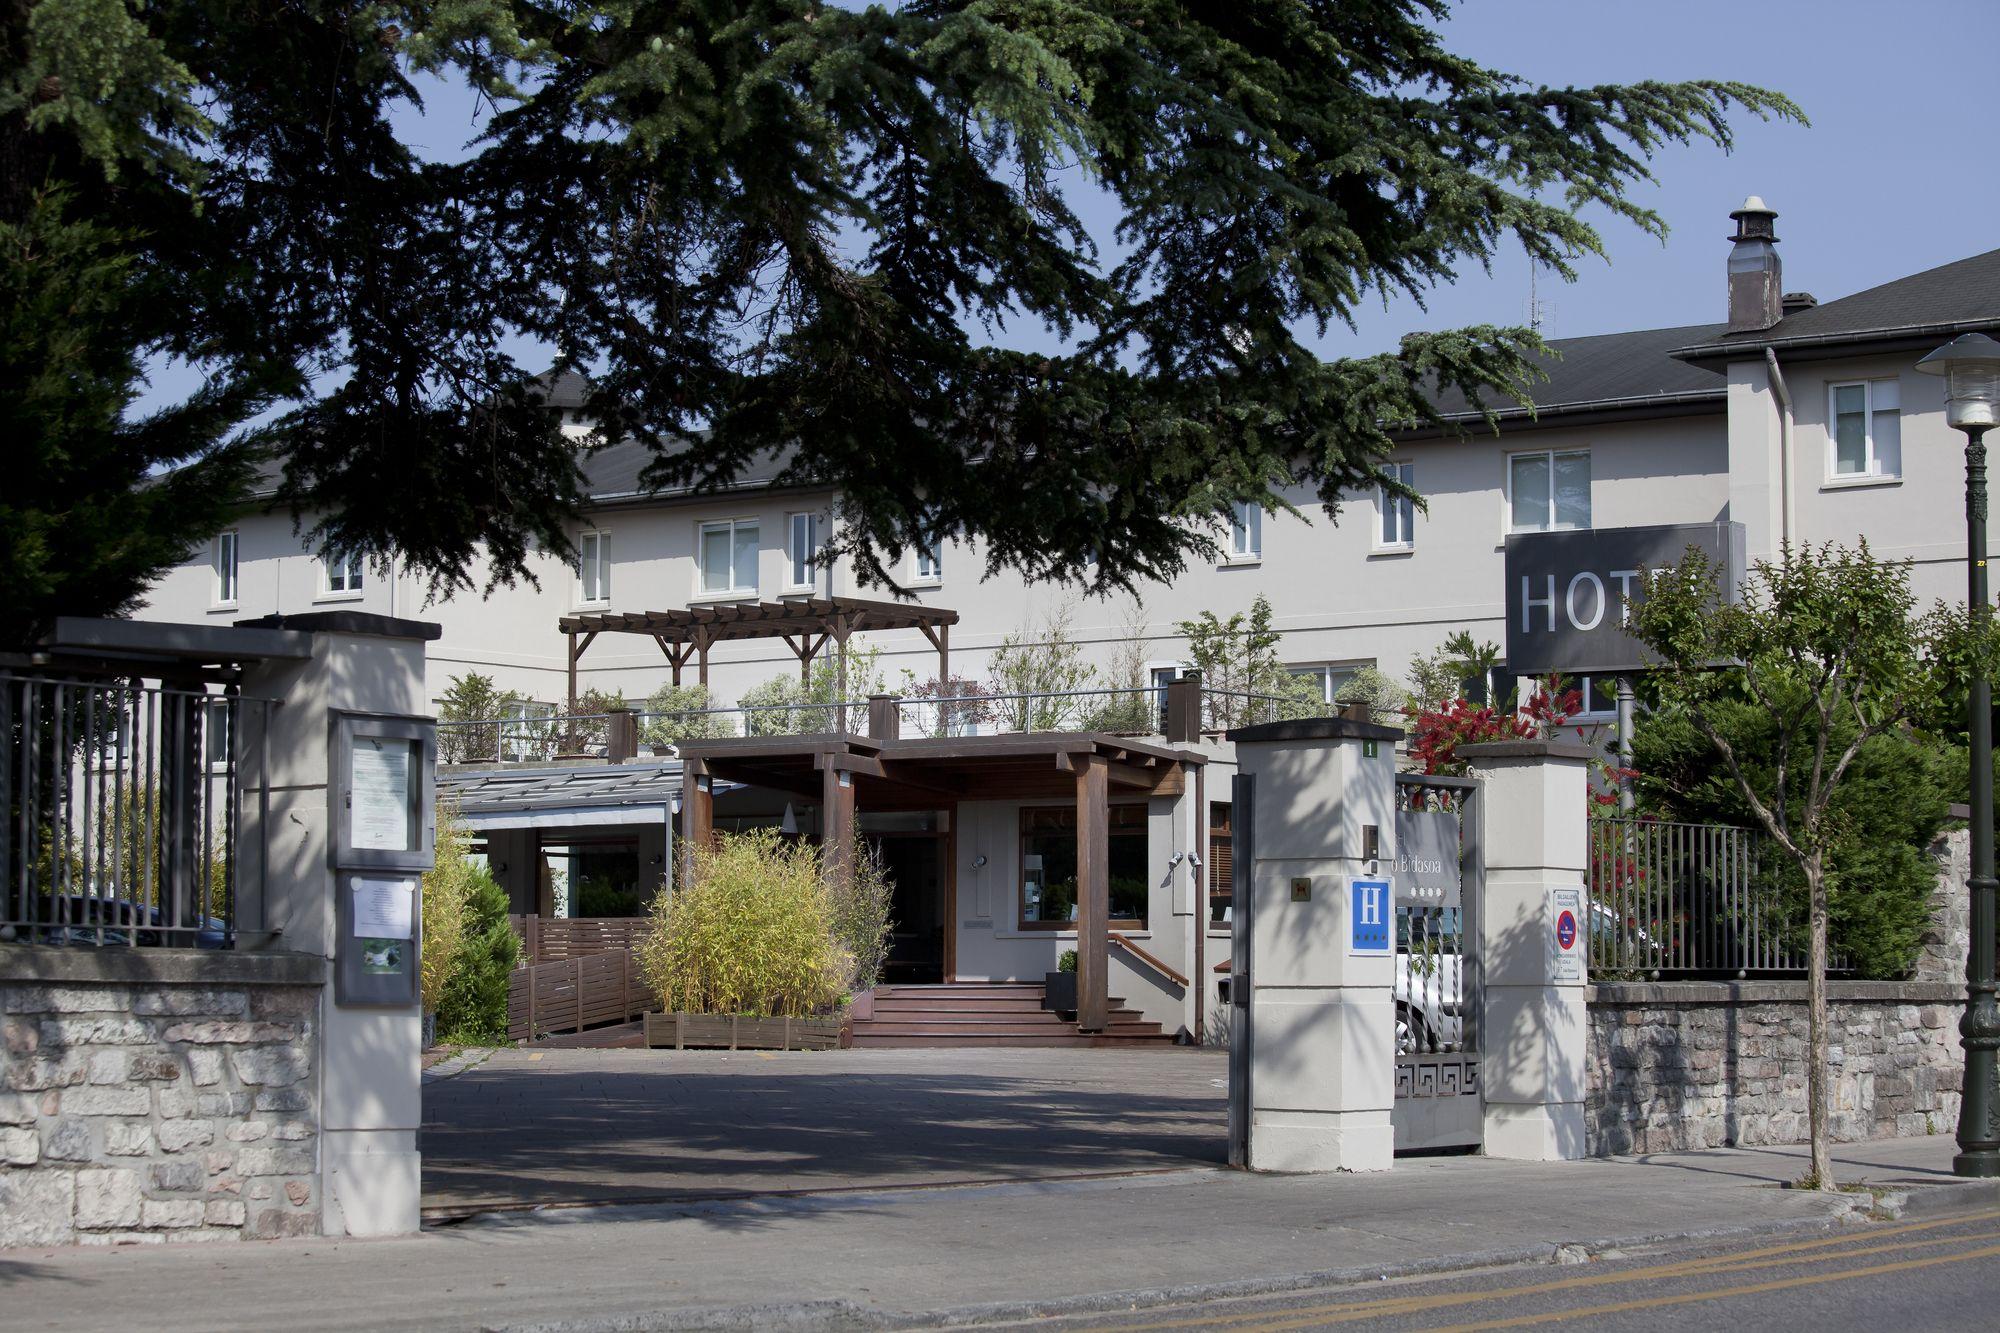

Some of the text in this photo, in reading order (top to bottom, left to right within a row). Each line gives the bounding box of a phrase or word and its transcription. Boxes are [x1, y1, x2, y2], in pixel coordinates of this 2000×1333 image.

[1522, 568, 1697, 633] HOT
[1368, 743, 1372, 756] 1
[1401, 854, 1441, 874] Bidasoa
[1360, 887, 1381, 925] H
